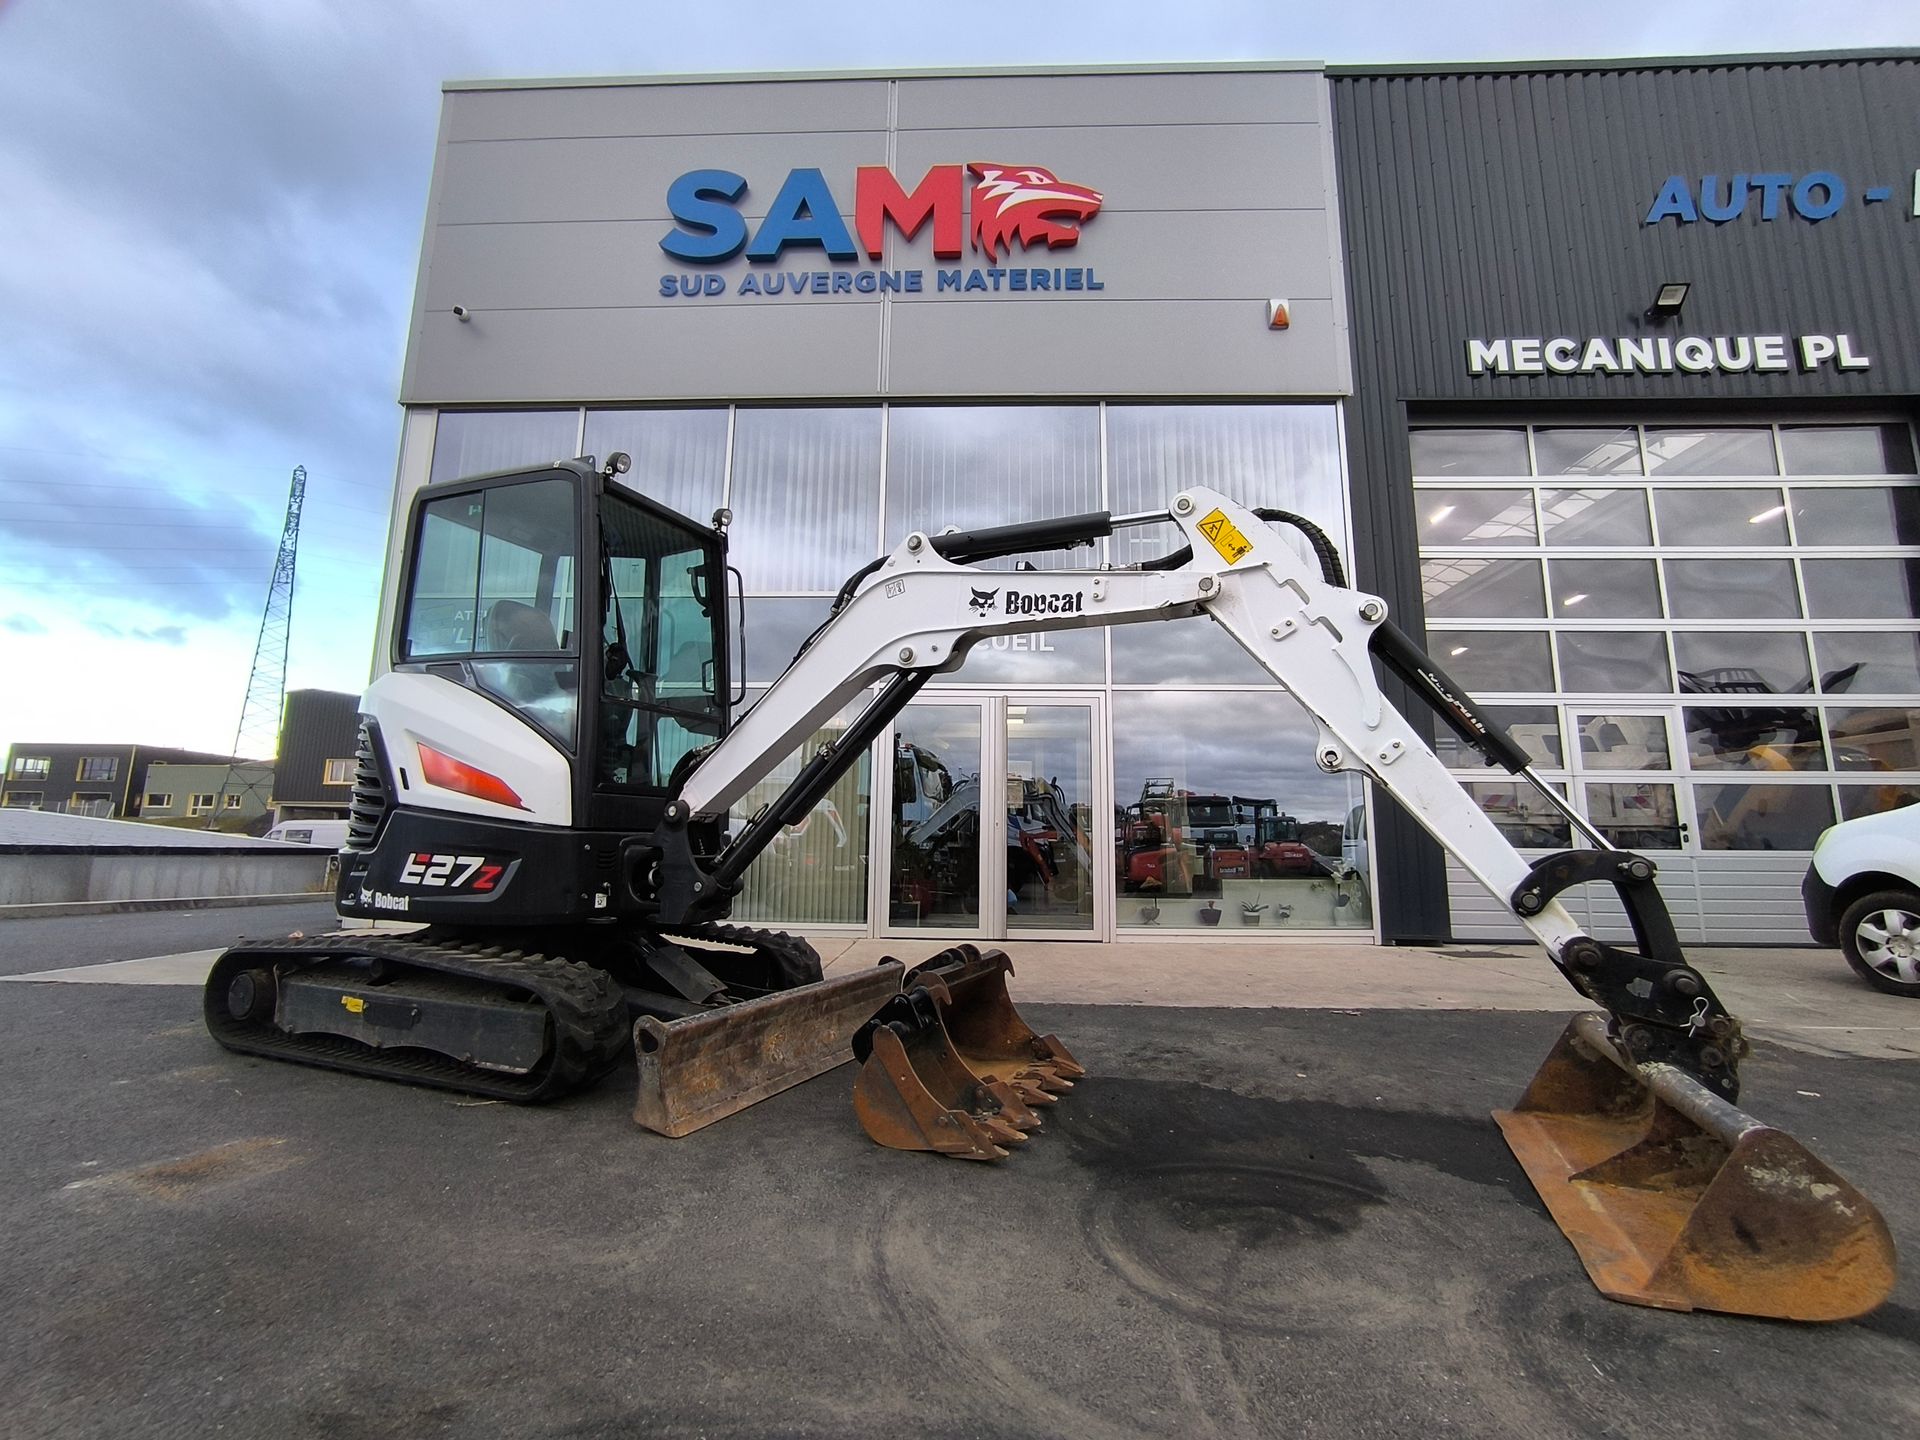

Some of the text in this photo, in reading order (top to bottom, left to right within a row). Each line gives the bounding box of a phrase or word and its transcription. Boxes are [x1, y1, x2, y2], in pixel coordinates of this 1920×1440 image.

[659, 164, 963, 263] SAM
[1646, 171, 1846, 223] AUTO
[659, 267, 1104, 297] SUD AUVERGNE MATERIEL
[1468, 333, 1870, 374] MECANIQUE PL
[1005, 591, 1083, 615] Bobcat
[375, 892, 409, 911] Bobcat
